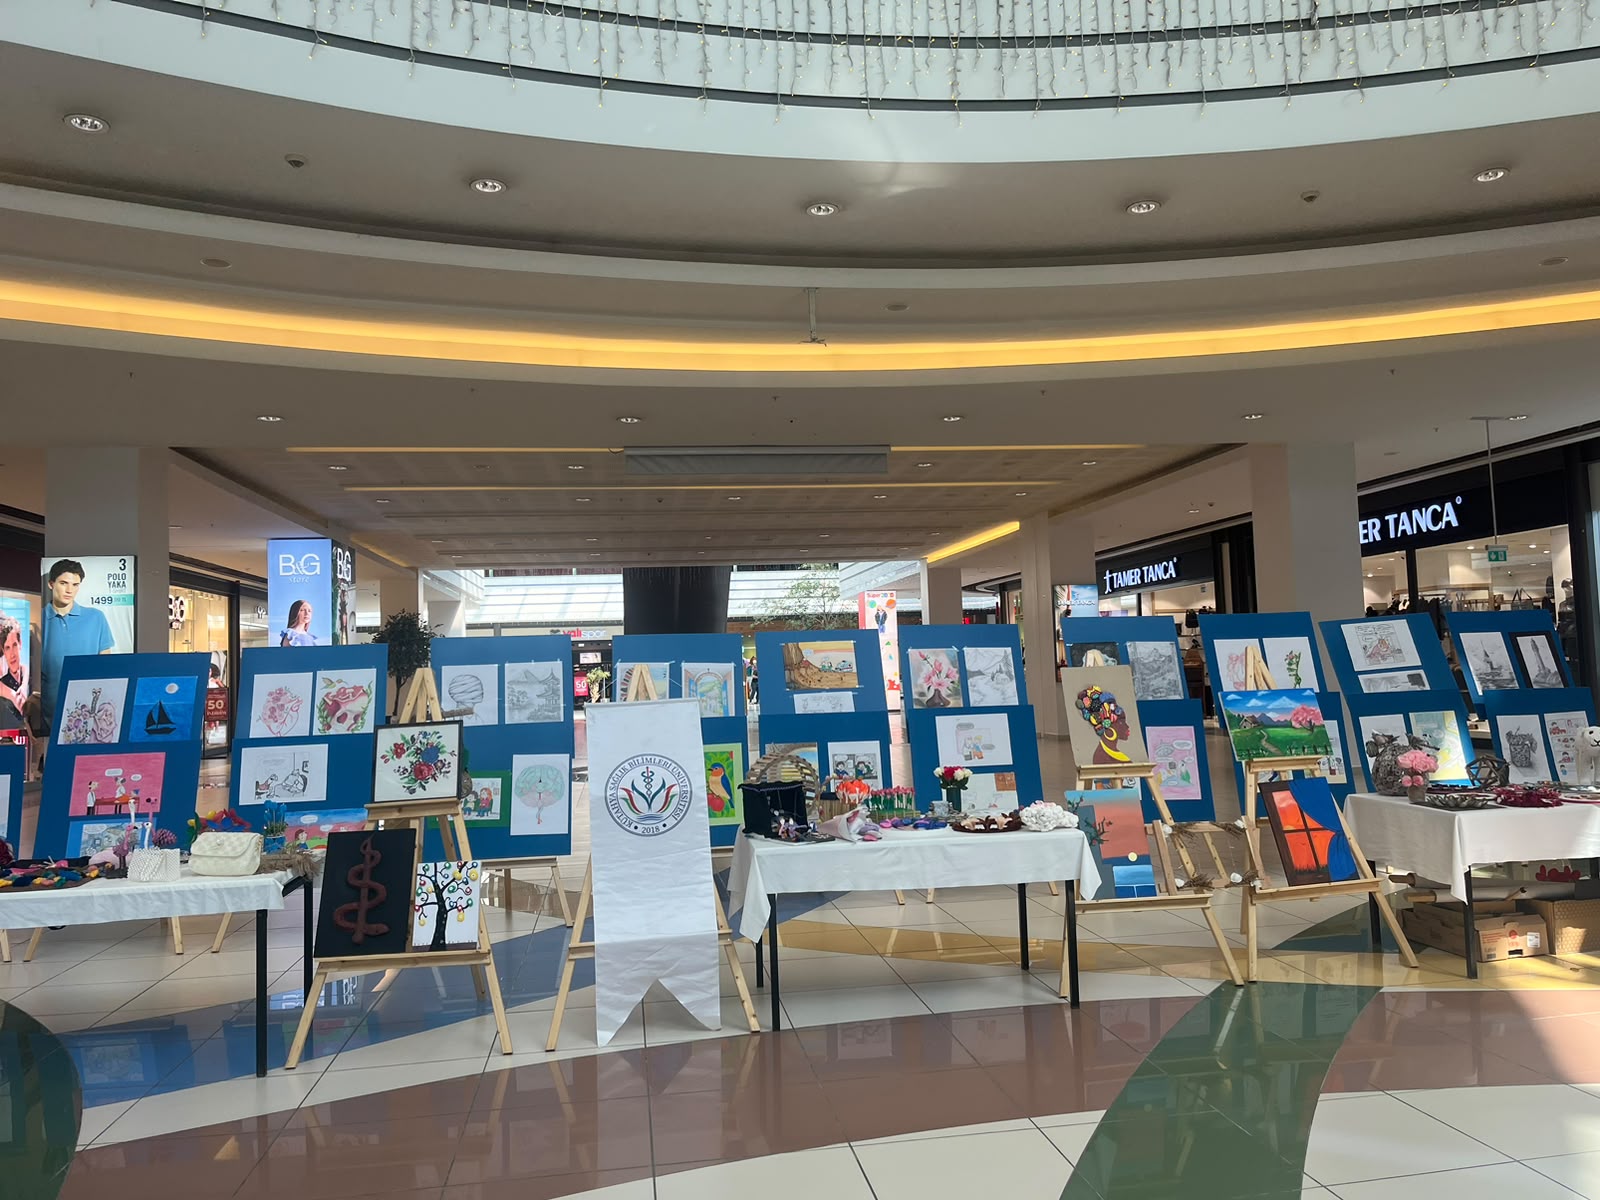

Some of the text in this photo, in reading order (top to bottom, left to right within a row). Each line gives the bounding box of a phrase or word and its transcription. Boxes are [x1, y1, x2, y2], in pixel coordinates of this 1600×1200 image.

[1359, 502, 1459, 544] ER TANCA
[119, 558, 127, 571] 3
[279, 553, 320, 576] B&G
[107, 573, 127, 581] POLO
[1112, 560, 1176, 588] TAMER TANCA
[107, 580, 127, 588] YAKA
[90, 596, 113, 605] 1499
[575, 681, 587, 689] 50
[207, 699, 224, 710] 50
[641, 825, 660, 834] 2018
